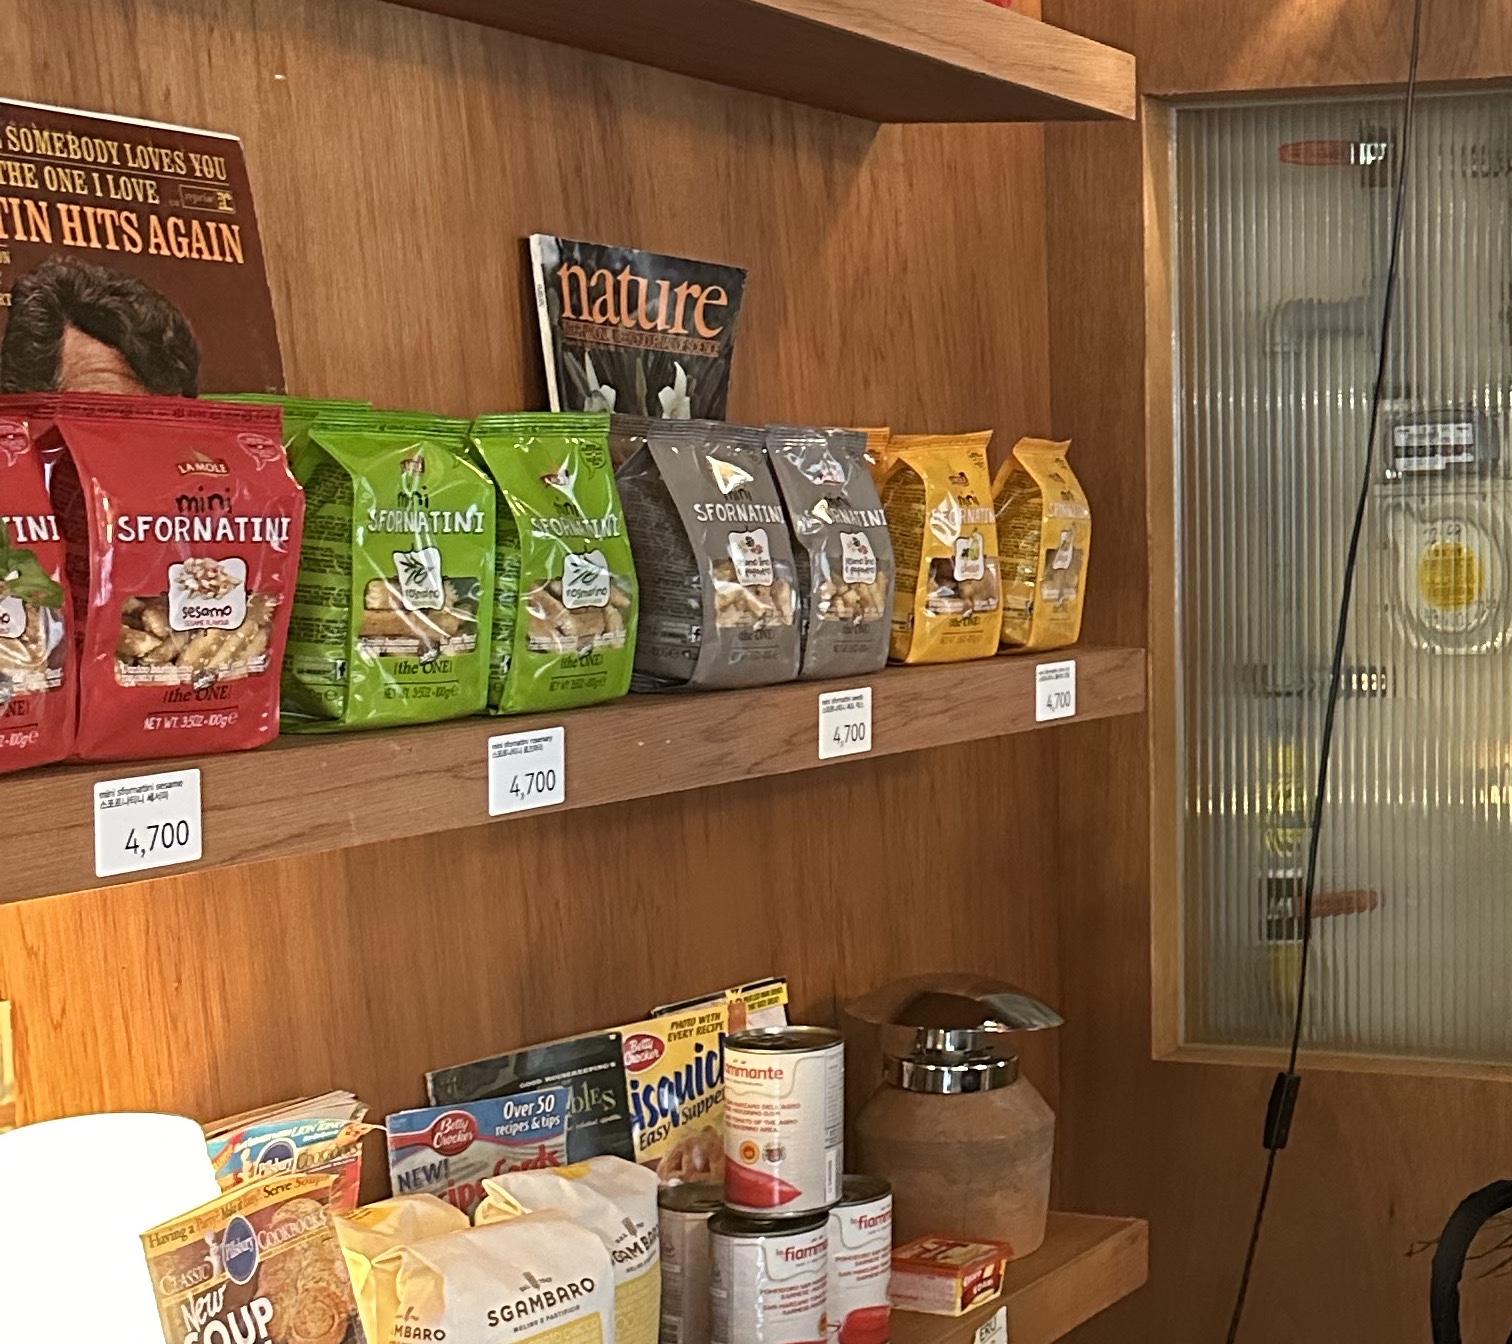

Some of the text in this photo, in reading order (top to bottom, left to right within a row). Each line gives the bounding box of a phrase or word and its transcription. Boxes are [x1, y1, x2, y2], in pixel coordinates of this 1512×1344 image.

[6, 125, 227, 181] SOMEBODY LOVES YOU
[44, 166, 88, 195] ONE
[92, 173, 103, 197] I
[106, 174, 160, 205] LOVE
[57, 203, 143, 254] HITS
[149, 214, 244, 264] AGAIN
[557, 262, 728, 338] nature
[176, 486, 233, 514] mini
[118, 515, 290, 544] SFORNATINI
[182, 605, 232, 619] sesamo
[1046, 690, 1071, 712] 4,700
[833, 722, 866, 748] 4,700
[510, 769, 556, 800] 4,700
[125, 820, 189, 858] 4,700
[667, 1020, 725, 1043] EVERY RECIPE
[670, 1011, 721, 1030] PHOTO WITH
[520, 1078, 543, 1089] GOOD
[503, 1094, 555, 1120] Over 50
[433, 1129, 474, 1149] Crocker
[441, 1117, 469, 1134] Betty
[495, 1122, 530, 1137] recipes
[532, 1119, 540, 1130] &
[541, 1114, 561, 1130] tips
[639, 1121, 672, 1152] Easy
[397, 1158, 449, 1192] NEW!
[149, 1226, 188, 1249] Having
[263, 1182, 292, 1199] Serve
[181, 1283, 226, 1333] New
[487, 1277, 595, 1328] SGAMBARO
